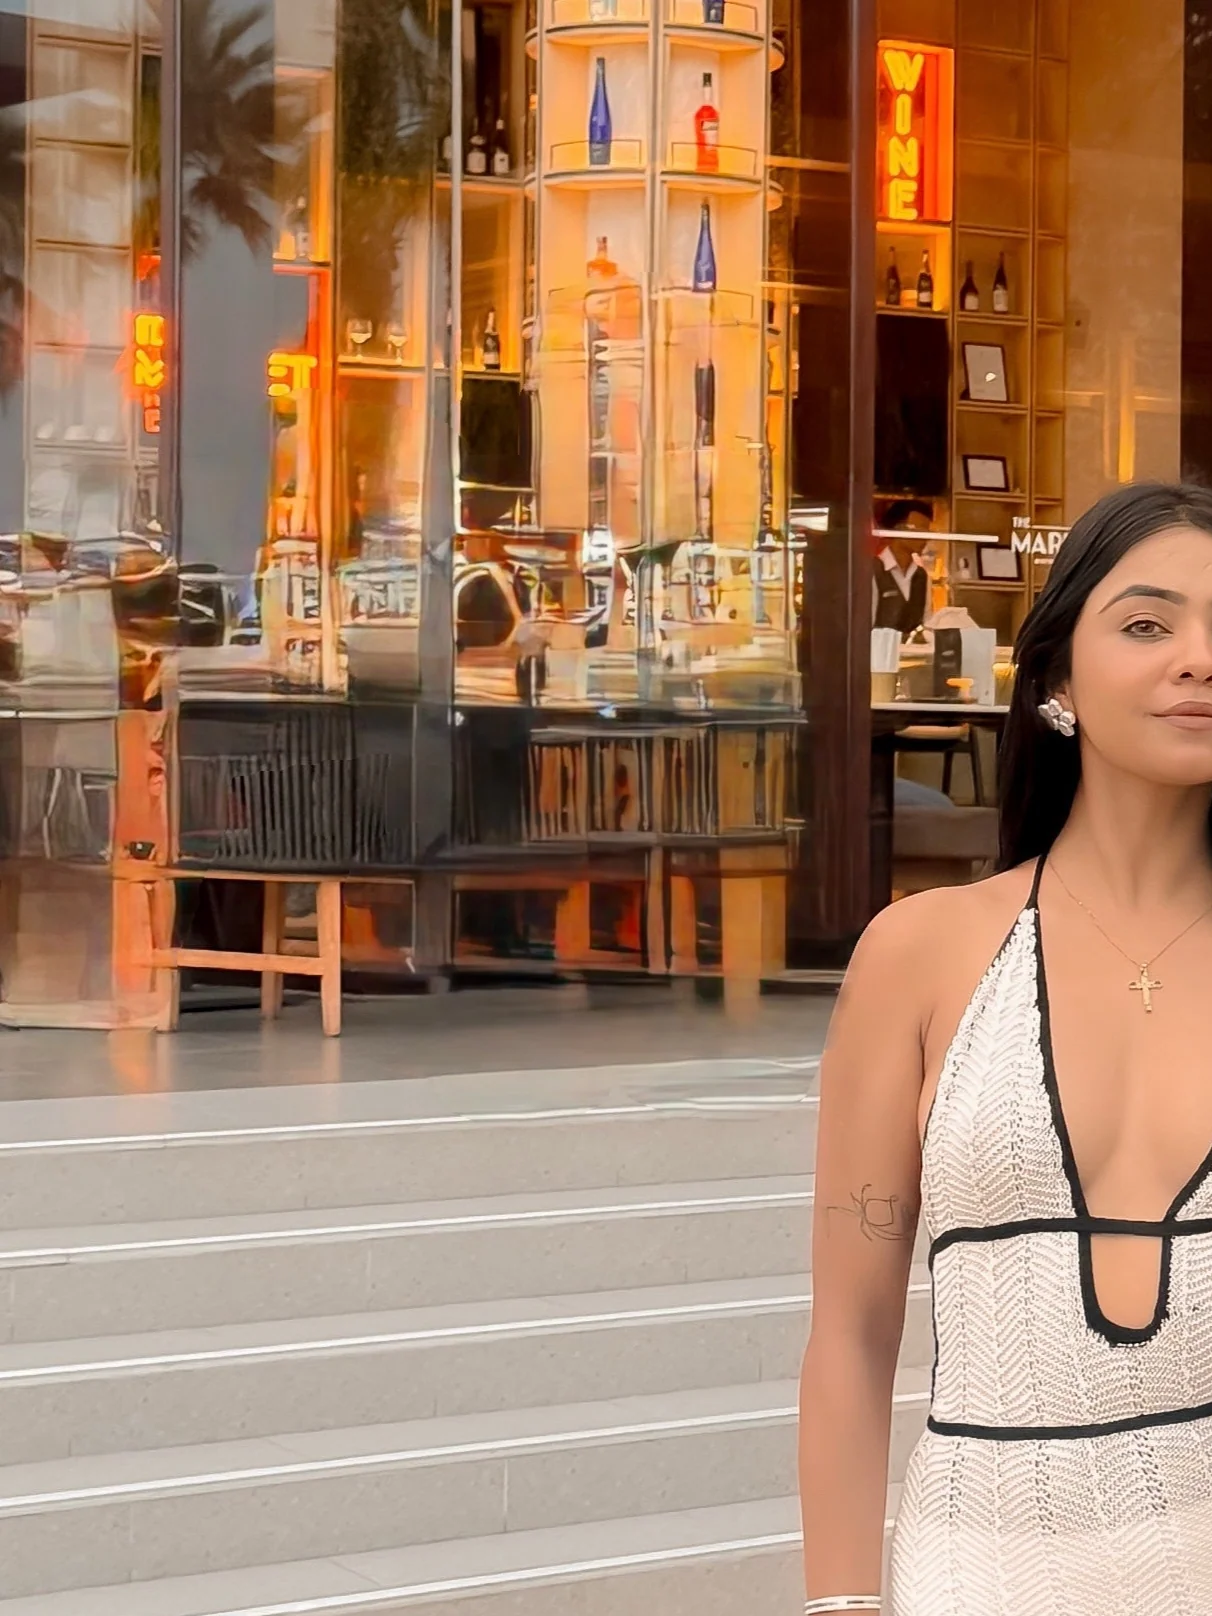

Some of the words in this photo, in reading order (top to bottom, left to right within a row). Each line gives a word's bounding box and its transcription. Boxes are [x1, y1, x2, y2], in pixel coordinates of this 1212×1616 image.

[883, 49, 925, 220] WINE
[1012, 516, 1031, 529] THE
[1011, 531, 1069, 554] MAR
